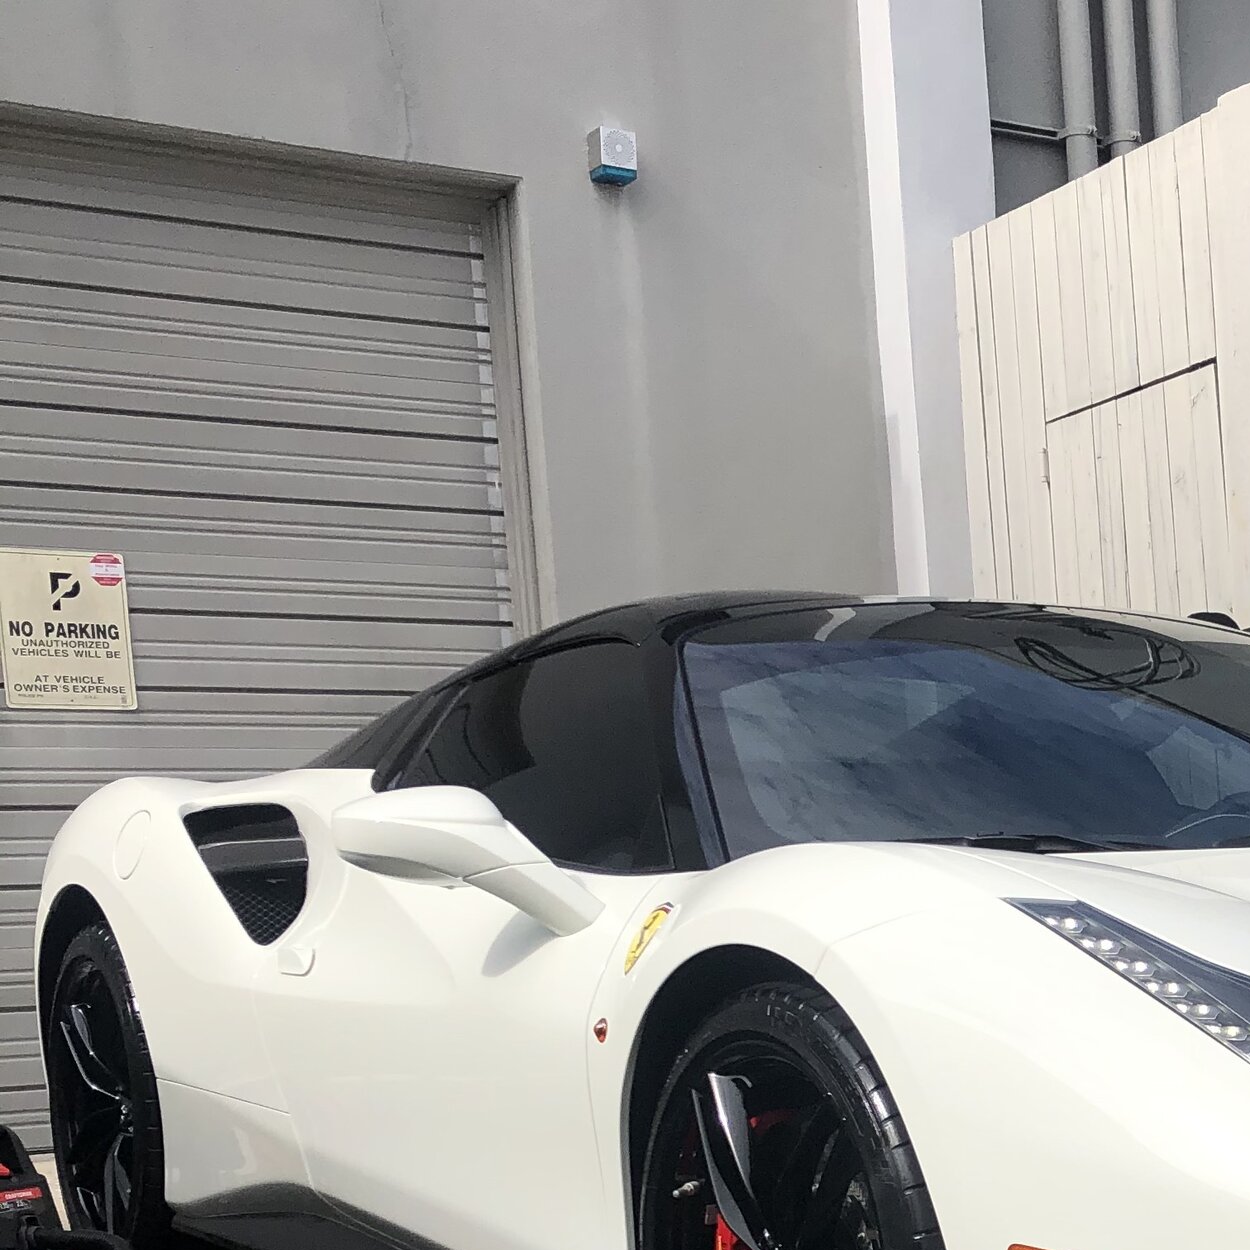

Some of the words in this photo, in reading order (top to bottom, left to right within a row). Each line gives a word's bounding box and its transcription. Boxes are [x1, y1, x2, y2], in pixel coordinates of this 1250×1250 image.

[8, 620, 33, 637] NO
[44, 622, 120, 640] PARKING
[21, 639, 110, 649] UNAUTHORIZED
[12, 647, 69, 658] VEHICLES
[73, 649, 101, 659] WILL
[106, 651, 121, 659] BE
[34, 675, 49, 683] AT
[54, 675, 105, 684] VEHICLE
[14, 683, 70, 693] OWNER'S
[73, 685, 126, 694] EXPENSE
